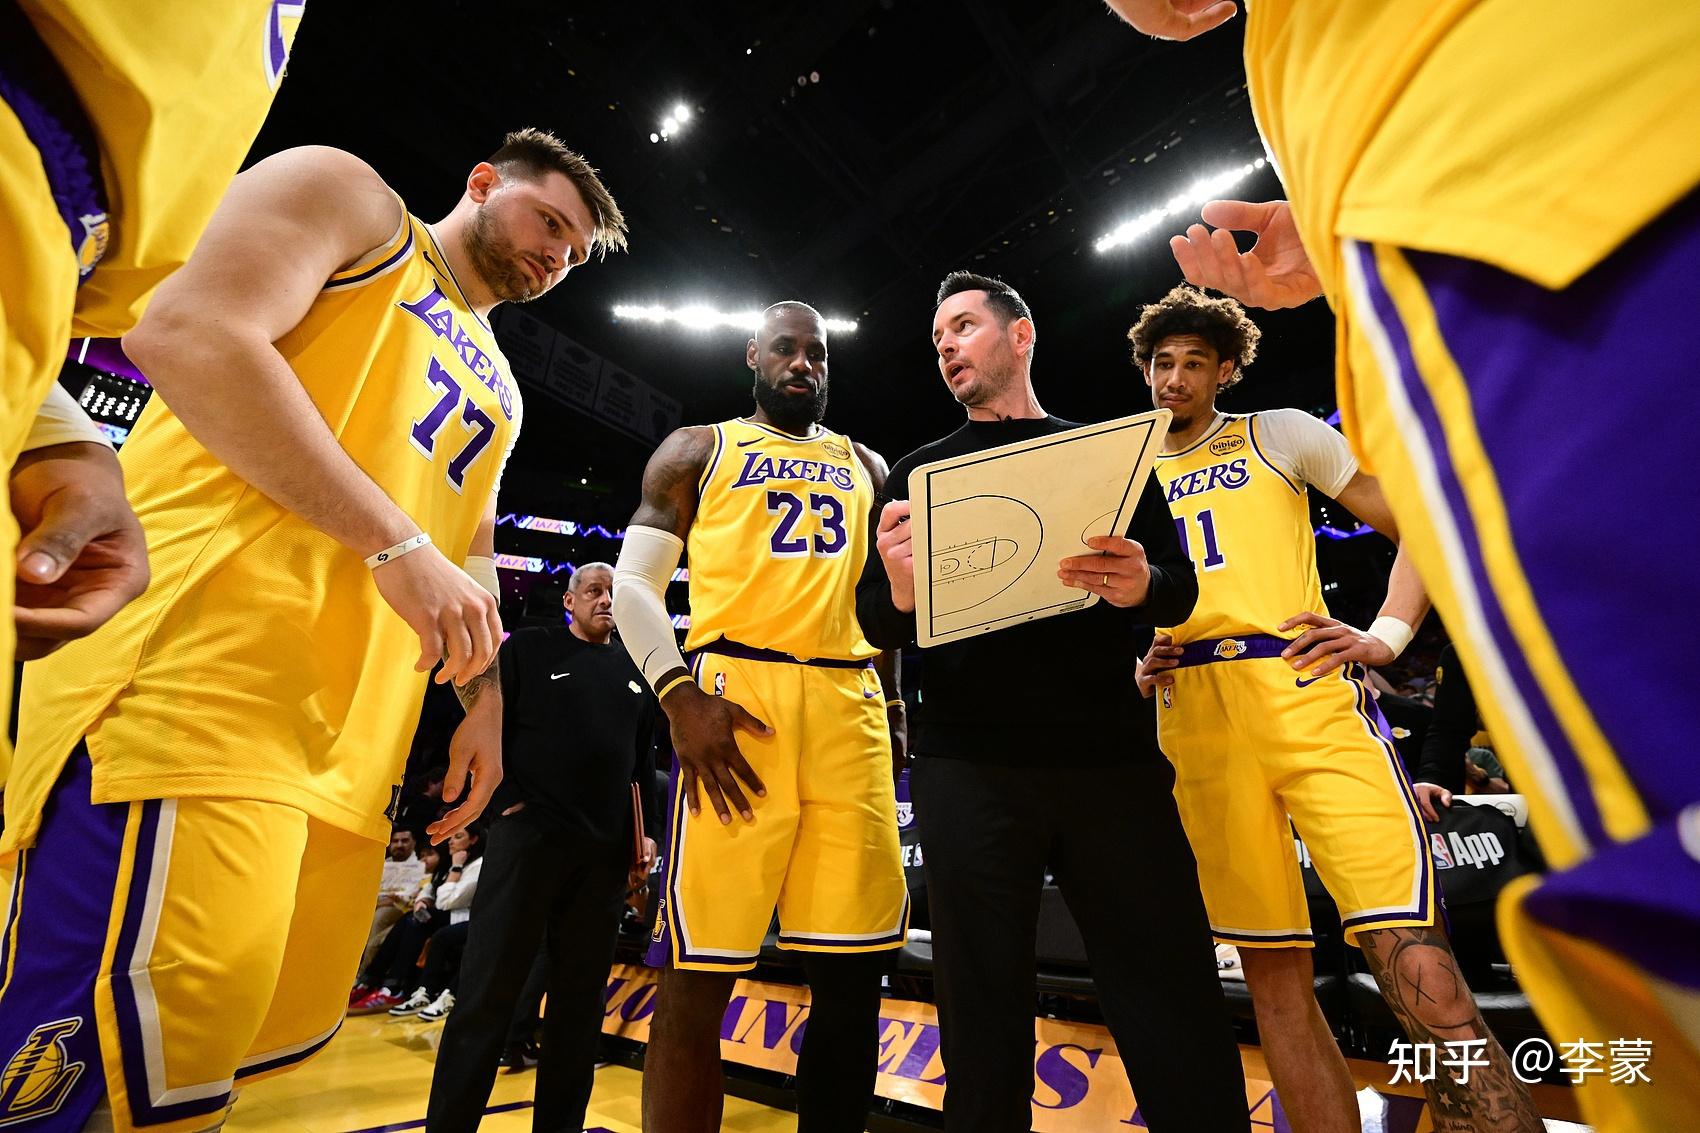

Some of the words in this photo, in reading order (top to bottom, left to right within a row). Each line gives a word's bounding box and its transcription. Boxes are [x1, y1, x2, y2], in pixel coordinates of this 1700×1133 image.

[396, 278, 513, 422] LAKERS
[409, 352, 496, 496] 77
[1212, 439, 1243, 450] bibigo
[731, 451, 855, 492] LAKERS
[1160, 458, 1251, 503] KERS
[766, 490, 848, 558] 23
[1448, 831, 1505, 870] App
